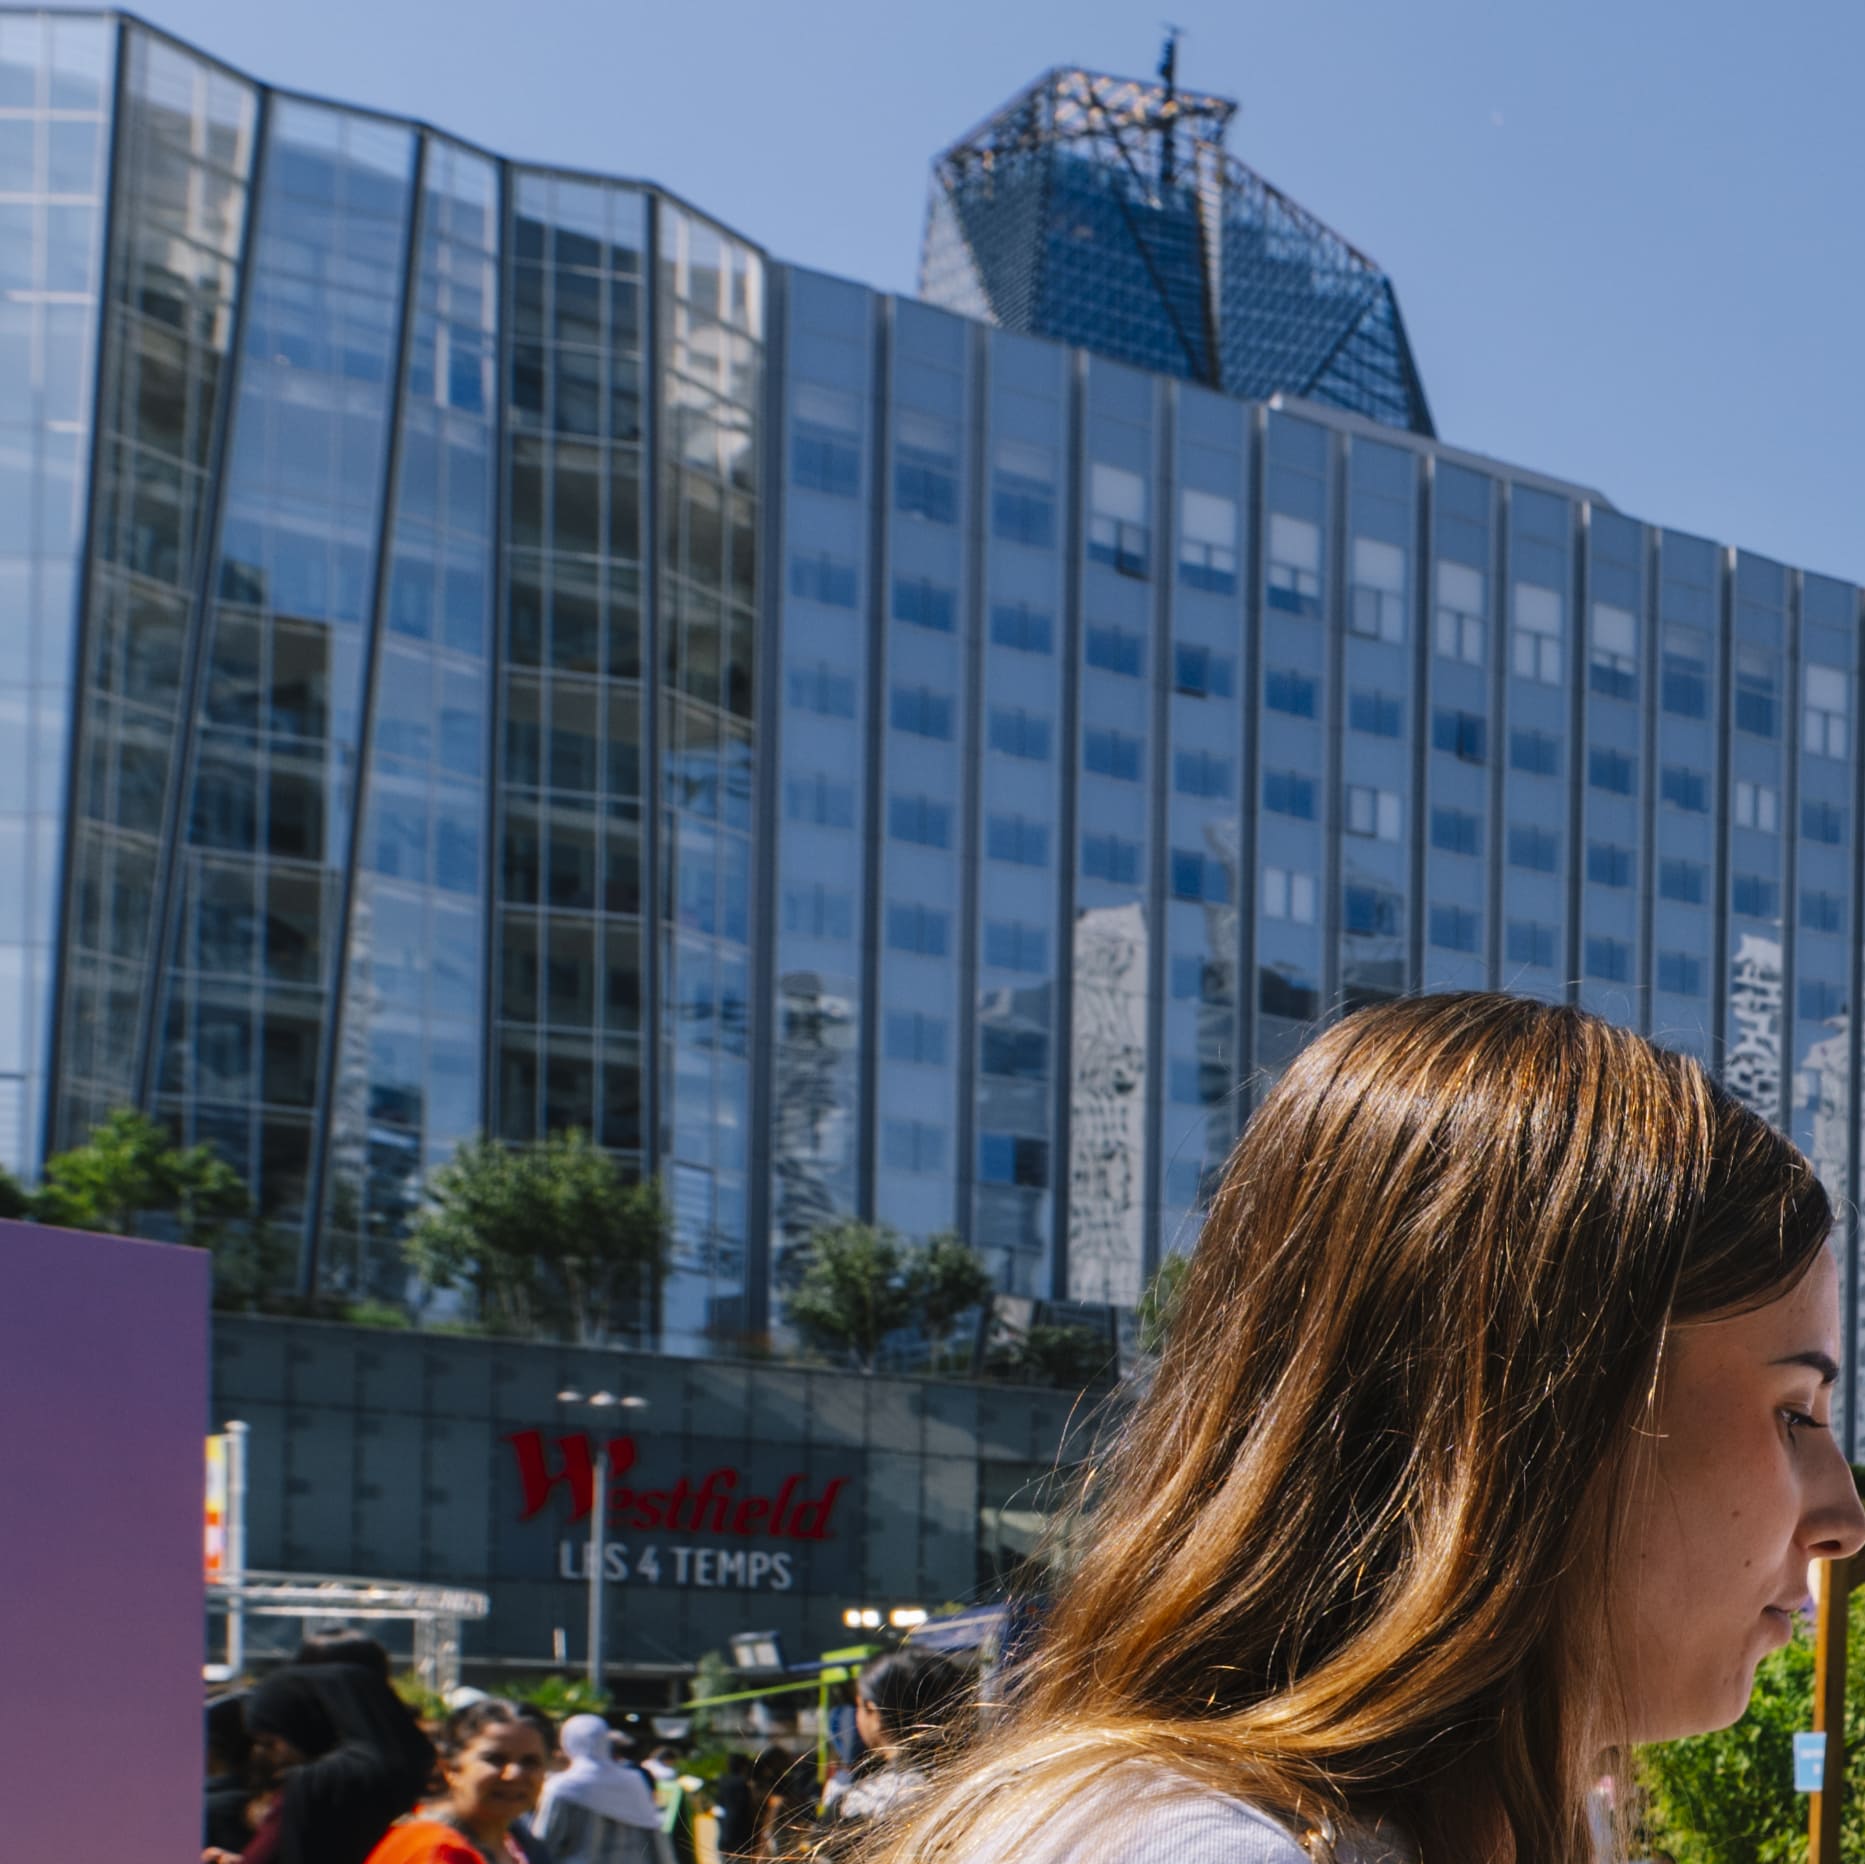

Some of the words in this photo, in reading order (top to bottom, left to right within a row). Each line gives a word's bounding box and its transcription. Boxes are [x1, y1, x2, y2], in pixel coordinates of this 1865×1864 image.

[500, 1429, 852, 1541] Westfield
[636, 1545, 661, 1584] 4
[670, 1546, 793, 1591] TEMPS
